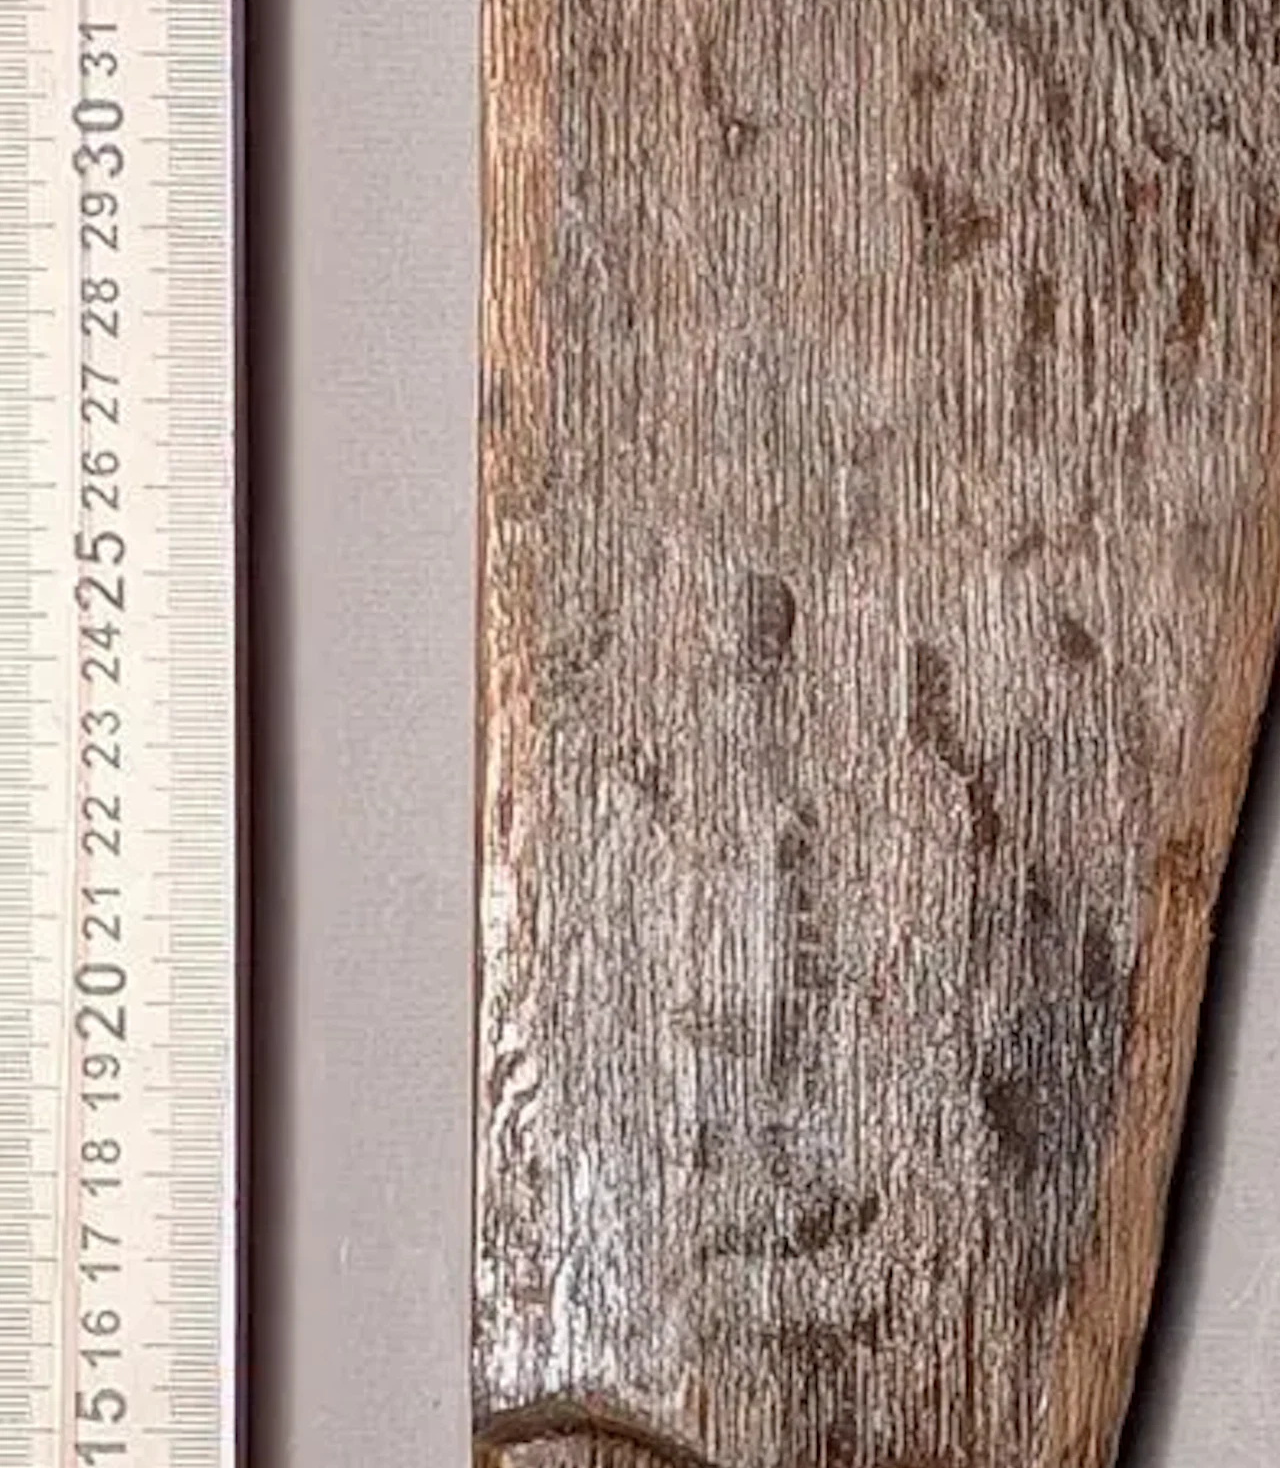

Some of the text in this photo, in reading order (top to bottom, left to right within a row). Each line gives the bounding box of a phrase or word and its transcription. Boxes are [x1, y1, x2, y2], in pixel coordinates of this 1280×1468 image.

[78, 24, 118, 76] 31
[72, 99, 124, 178] 30
[79, 191, 119, 252] 29
[80, 278, 119, 338] 28
[79, 363, 119, 424] 27
[80, 450, 120, 511] 26
[74, 532, 126, 611] 25
[79, 622, 121, 683] 24
[80, 711, 121, 768] 23
[81, 797, 121, 855] 22
[81, 888, 121, 941] 21
[73, 964, 127, 1041] 20
[80, 1055, 121, 1110] 19
[79, 1140, 122, 1196] 18
[79, 1225, 121, 1281] 17
[78, 1311, 122, 1367] 16
[73, 1389, 127, 1465] 15
